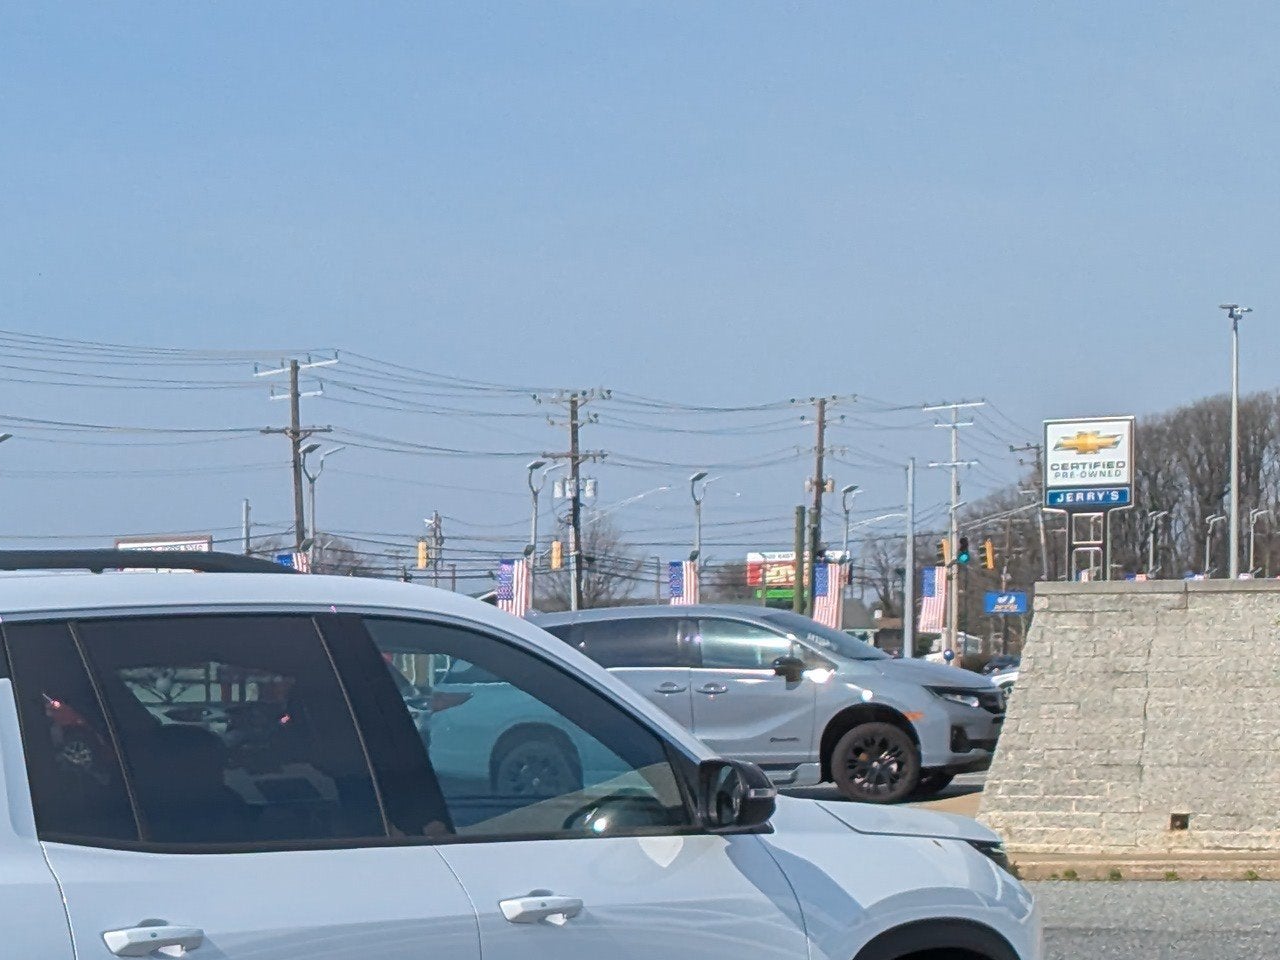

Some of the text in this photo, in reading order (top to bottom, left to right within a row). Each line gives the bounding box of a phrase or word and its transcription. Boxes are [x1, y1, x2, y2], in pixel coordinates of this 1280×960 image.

[1051, 461, 1126, 471] CERTIFIED
[1055, 470, 1121, 478] PRE-OWNED
[1057, 490, 1120, 502] JERRY'S
